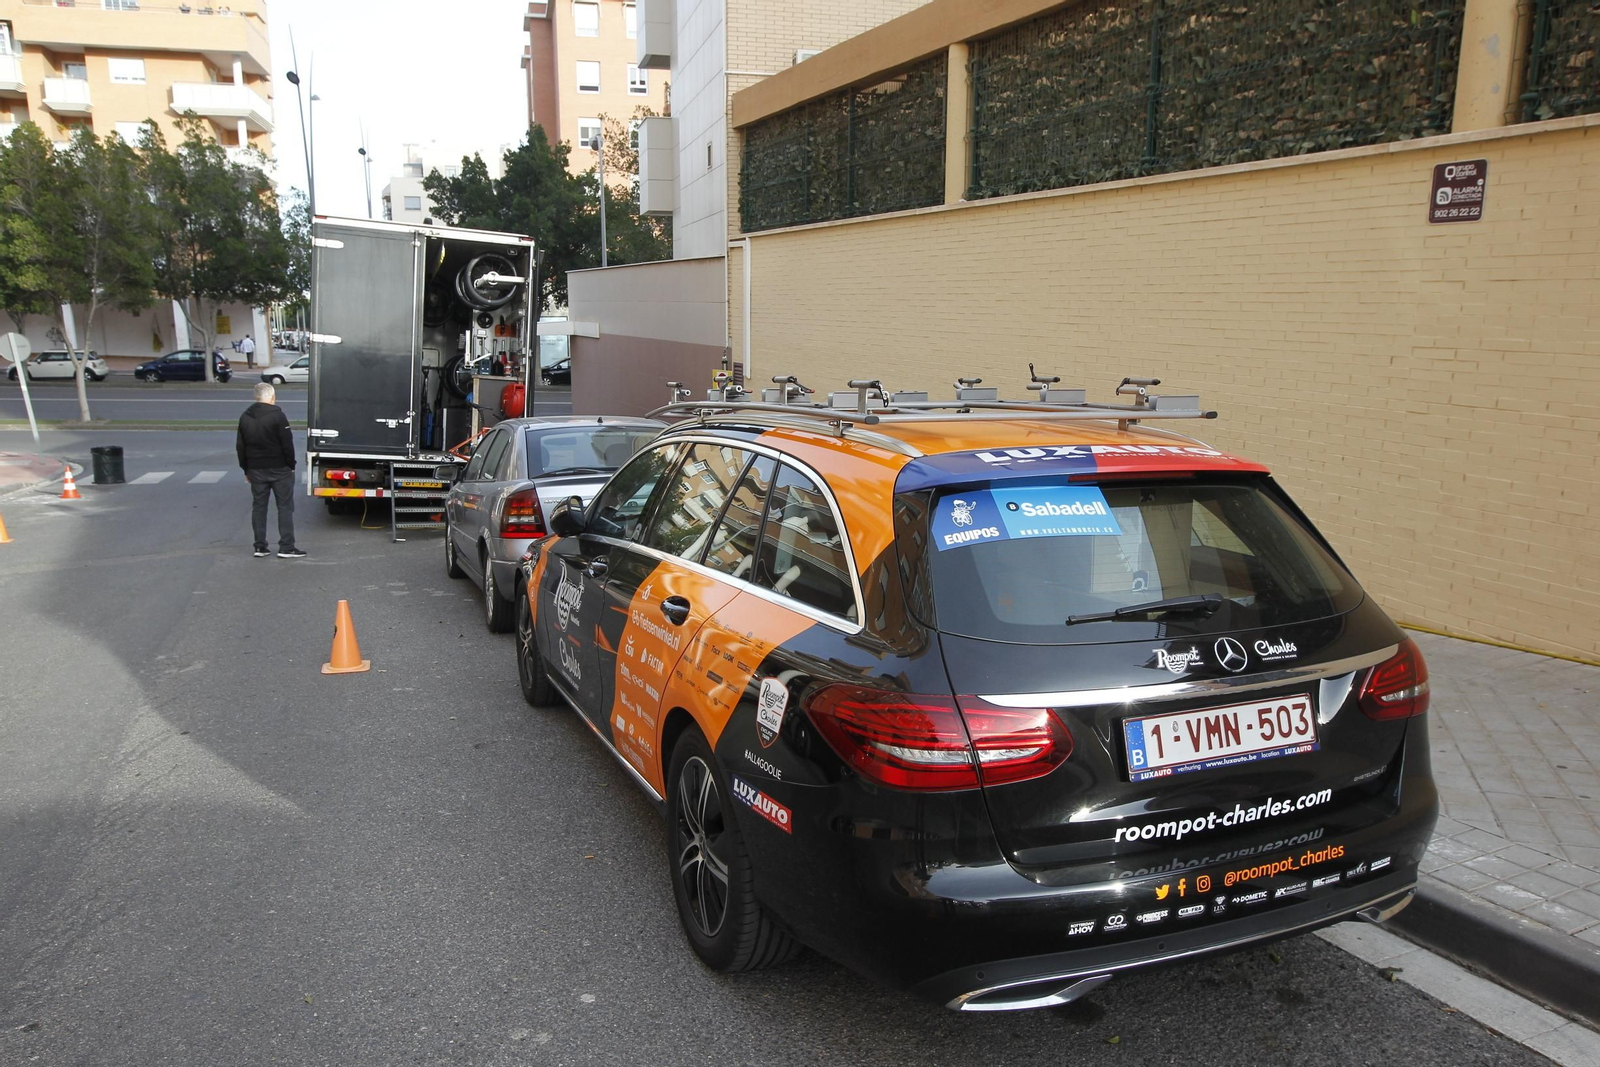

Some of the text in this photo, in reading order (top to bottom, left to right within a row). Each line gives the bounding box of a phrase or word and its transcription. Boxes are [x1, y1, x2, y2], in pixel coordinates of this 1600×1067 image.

[1453, 186, 1482, 195] ALARMA
[1434, 207, 1480, 218] 902 26 22 22
[1020, 501, 1107, 517] Sabadell
[944, 526, 1000, 545] EQUIPOS
[1254, 638, 1298, 656] Charles
[647, 653, 664, 675] FACTOR
[1152, 645, 1201, 673] Roompot
[1151, 703, 1310, 759] 1-VMN-503
[744, 749, 782, 781] #ALL4GOOLIE
[1132, 749, 1144, 766] B
[1140, 744, 1312, 780] LUXAUTO verhuring www.luxauto.be location LUXAUTO
[733, 777, 788, 824] LUXAUTO
[1114, 788, 1332, 843] roompot-charles.com
[1224, 845, 1344, 887] @roompot_charles
[1240, 891, 1268, 903] DOMETIC
[1213, 904, 1226, 912] LUX
[1068, 925, 1094, 935] AHOY
